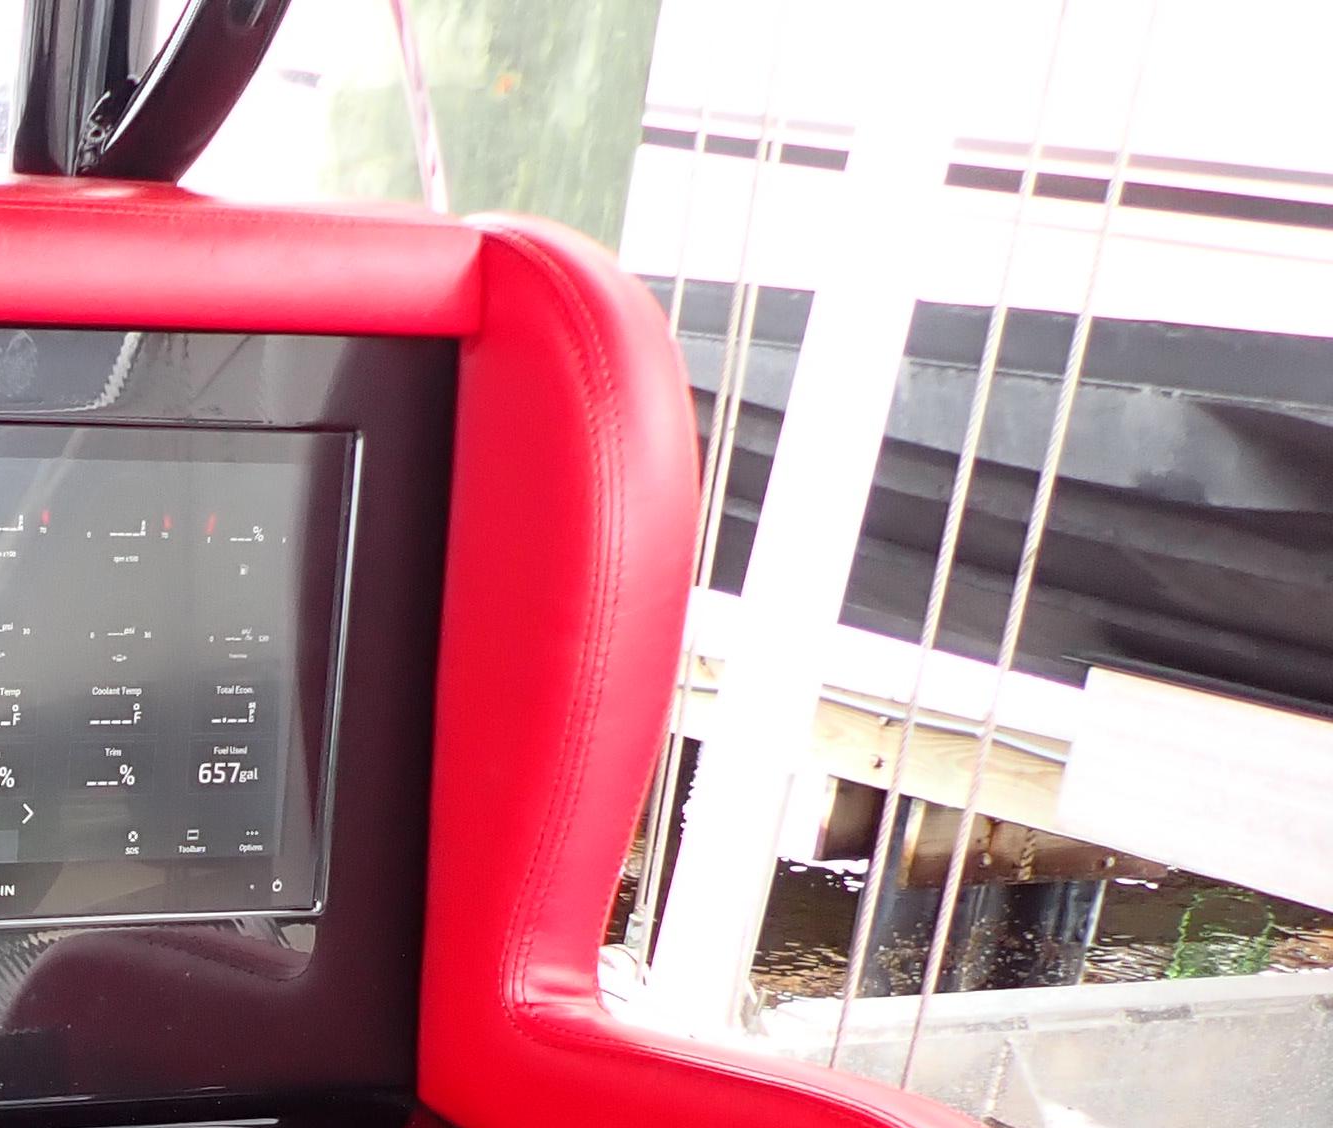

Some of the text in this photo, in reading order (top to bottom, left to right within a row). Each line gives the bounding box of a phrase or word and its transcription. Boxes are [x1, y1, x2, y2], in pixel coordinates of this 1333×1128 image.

[0, 687, 21, 698] Temp
[92, 686, 142, 697] Coolant Temp
[216, 685, 234, 694] Total
[105, 748, 122, 757] Trim
[213, 745, 248, 755] Fuel Used
[198, 762, 240, 783] 657
